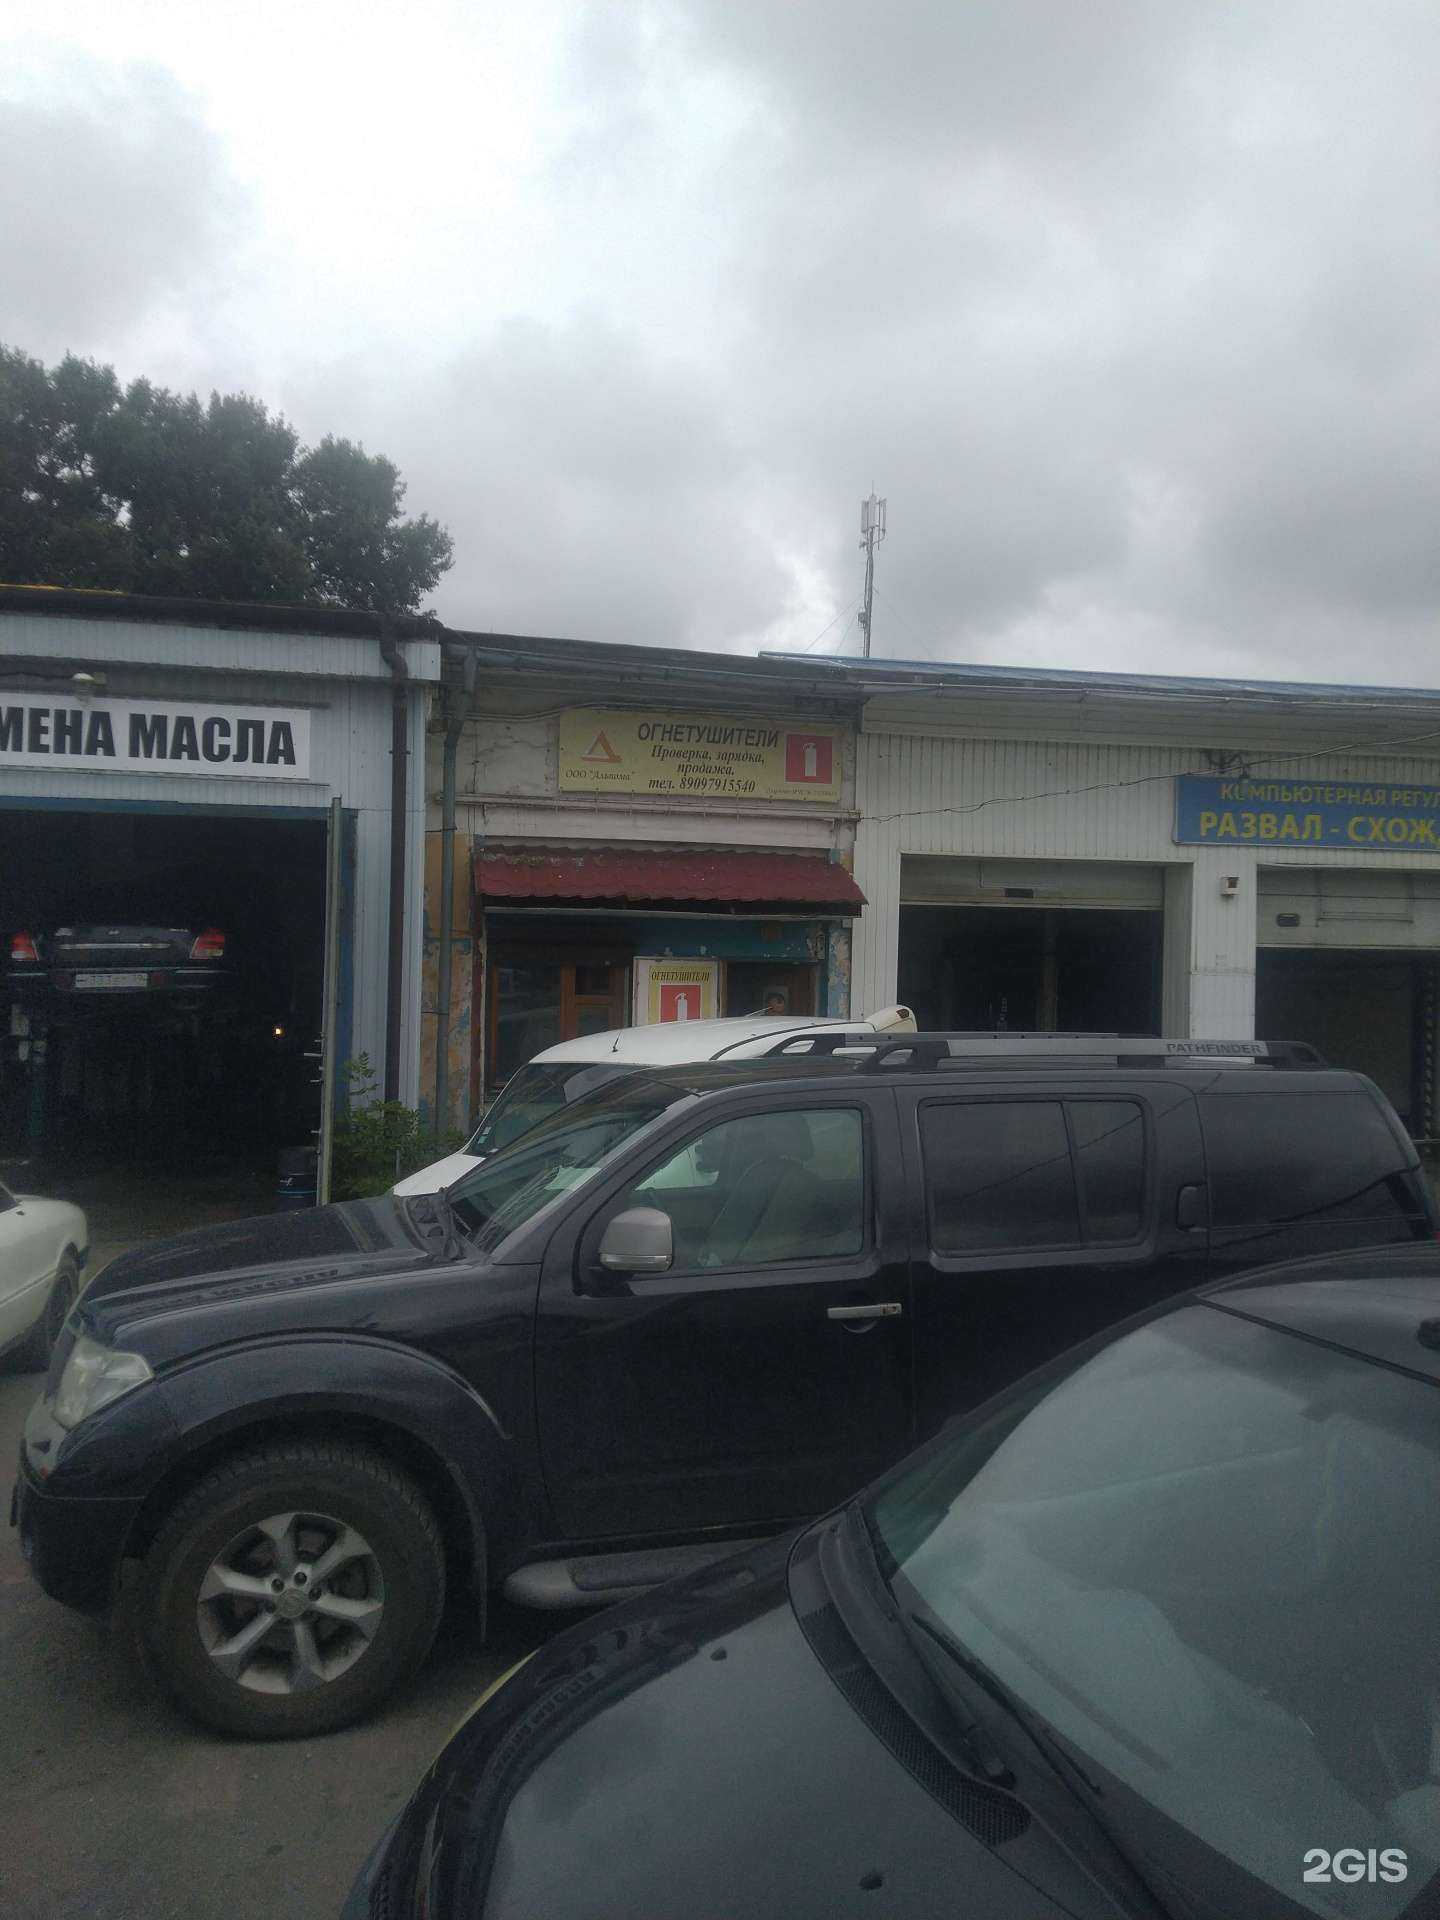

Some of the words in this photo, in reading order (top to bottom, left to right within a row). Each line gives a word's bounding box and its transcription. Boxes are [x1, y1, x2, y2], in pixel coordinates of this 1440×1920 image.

[128, 712, 296, 766] МАСЛА
[637, 722, 779, 748] ОГНЕТУШИТЕЛИ
[651, 744, 712, 762] Проверка,
[716, 750, 766, 765] зарядка,
[565, 769, 587, 779] ООО
[648, 778, 675, 790] тел.
[1199, 811, 1322, 841] РАЗВАЛ
[1347, 816, 1440, 848] СХОЖ
[651, 971, 710, 982] ОГНЕТУШИТЕЛИ
[1167, 1043, 1262, 1054] PATHFINDER
